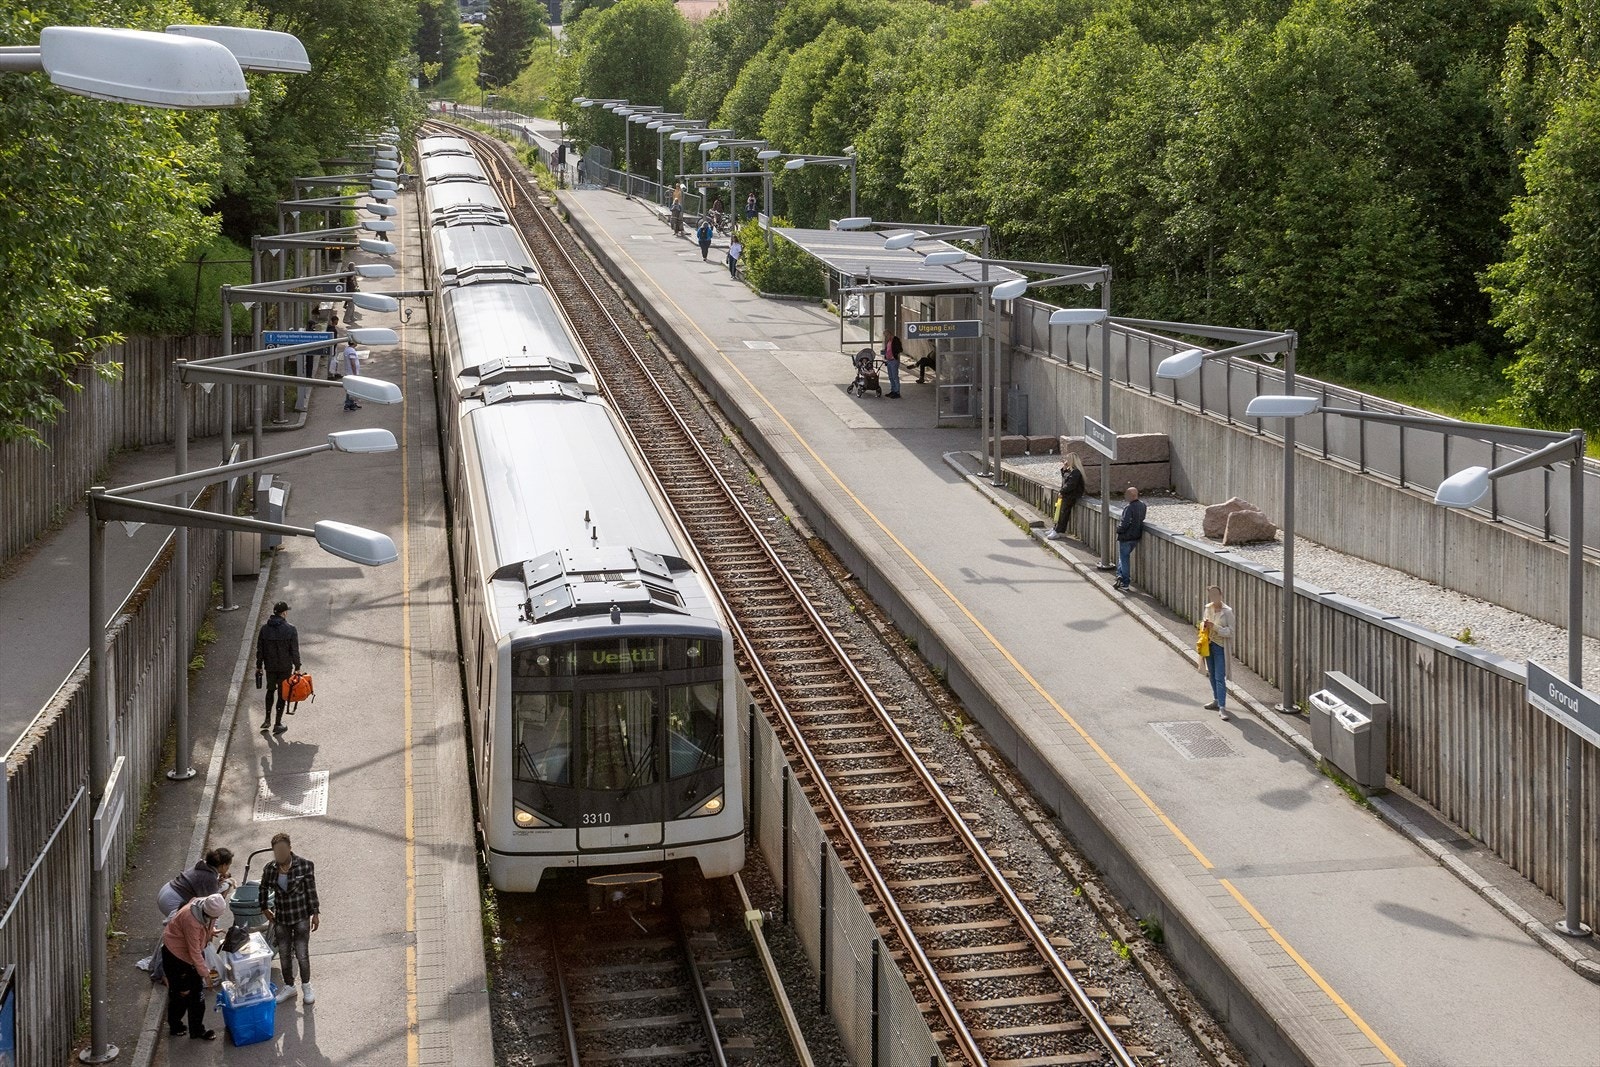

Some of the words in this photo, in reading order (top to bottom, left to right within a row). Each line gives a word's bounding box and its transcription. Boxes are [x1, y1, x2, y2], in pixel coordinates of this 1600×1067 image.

[918, 324, 942, 332] Utgang
[943, 323, 956, 331] Exit
[592, 648, 656, 664] Vestli
[1548, 682, 1579, 713] Grorud
[582, 812, 611, 824] 3310
